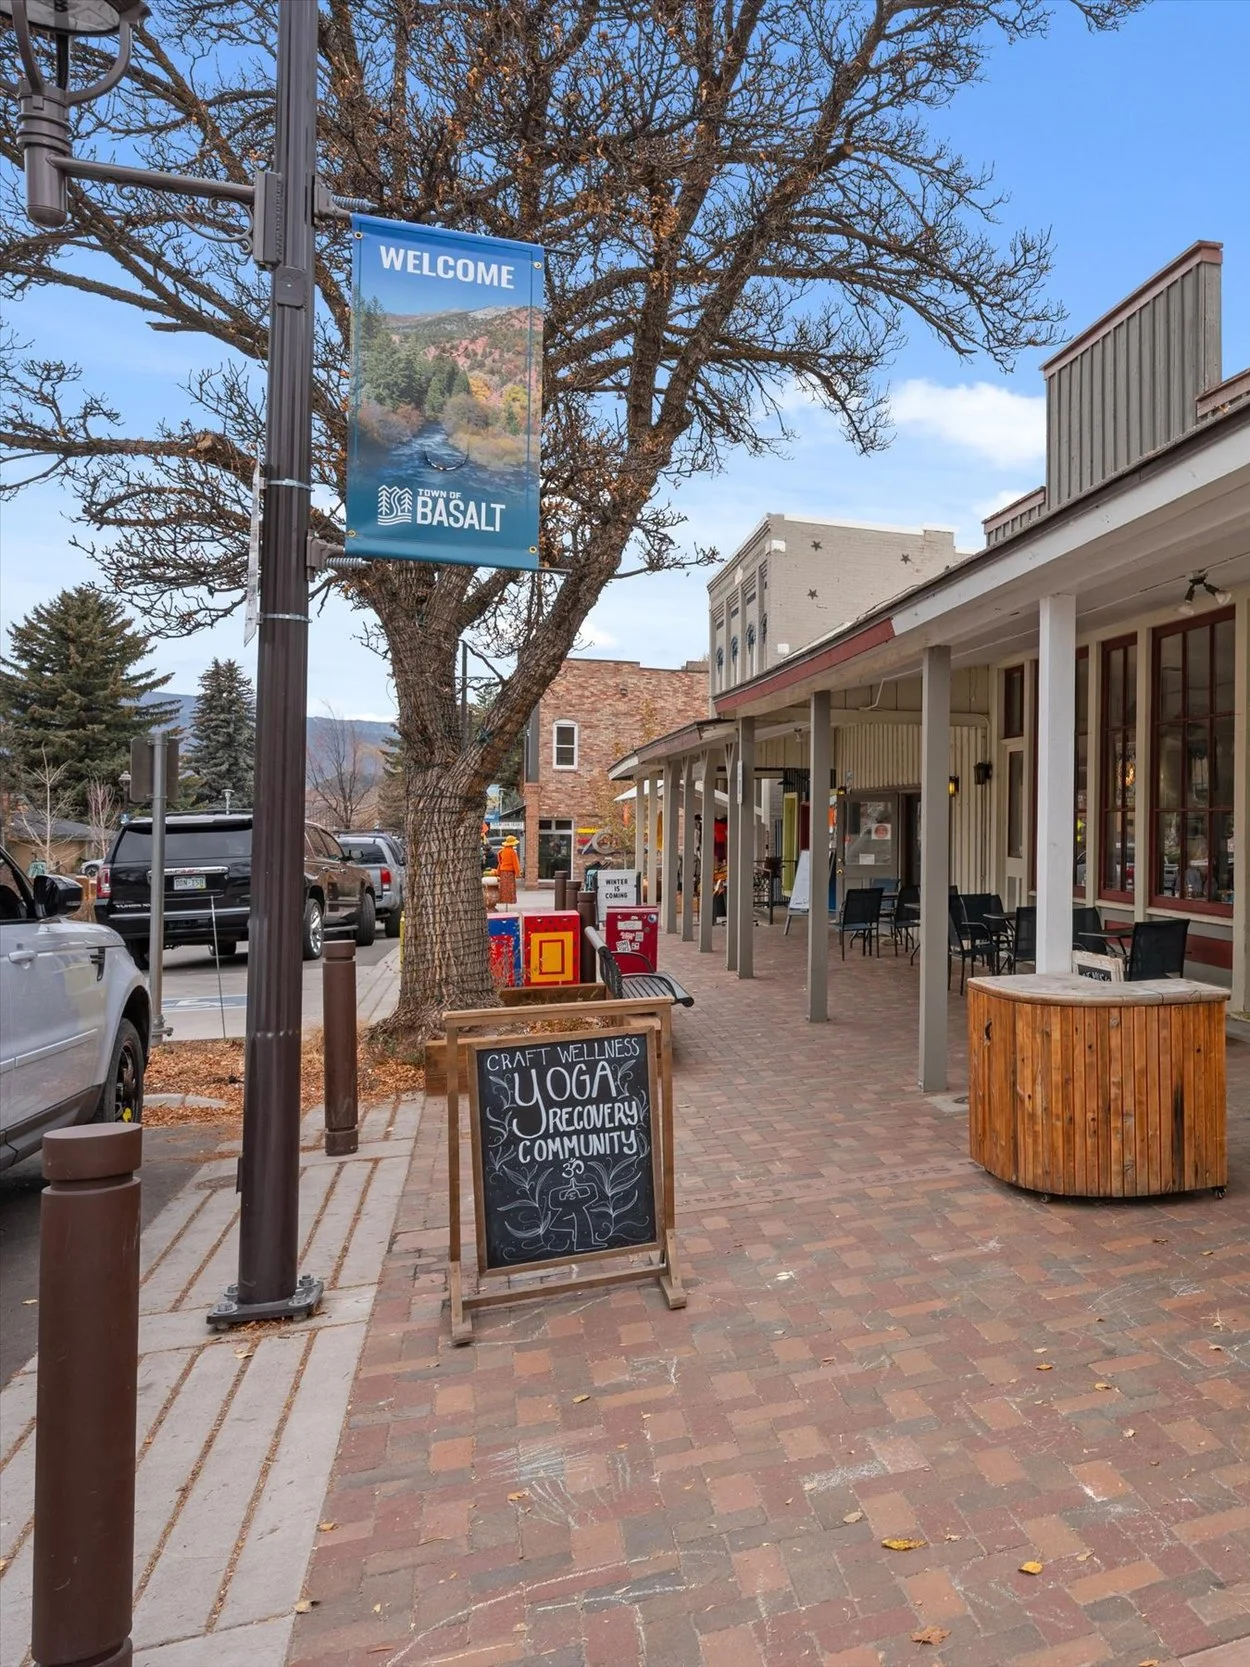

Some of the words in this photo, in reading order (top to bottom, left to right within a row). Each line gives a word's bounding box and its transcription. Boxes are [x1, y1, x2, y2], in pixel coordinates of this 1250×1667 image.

[379, 245, 515, 289] WELCOME
[418, 488, 447, 498] TOWN
[449, 491, 462, 499] OF
[416, 496, 506, 532] BASALT
[487, 1048, 551, 1071] CRAFT
[557, 1038, 640, 1064] WELLNESS
[513, 1061, 617, 1139] YOGA
[549, 1101, 638, 1133] RECOVERY
[518, 1130, 637, 1164] COMMUNITY
